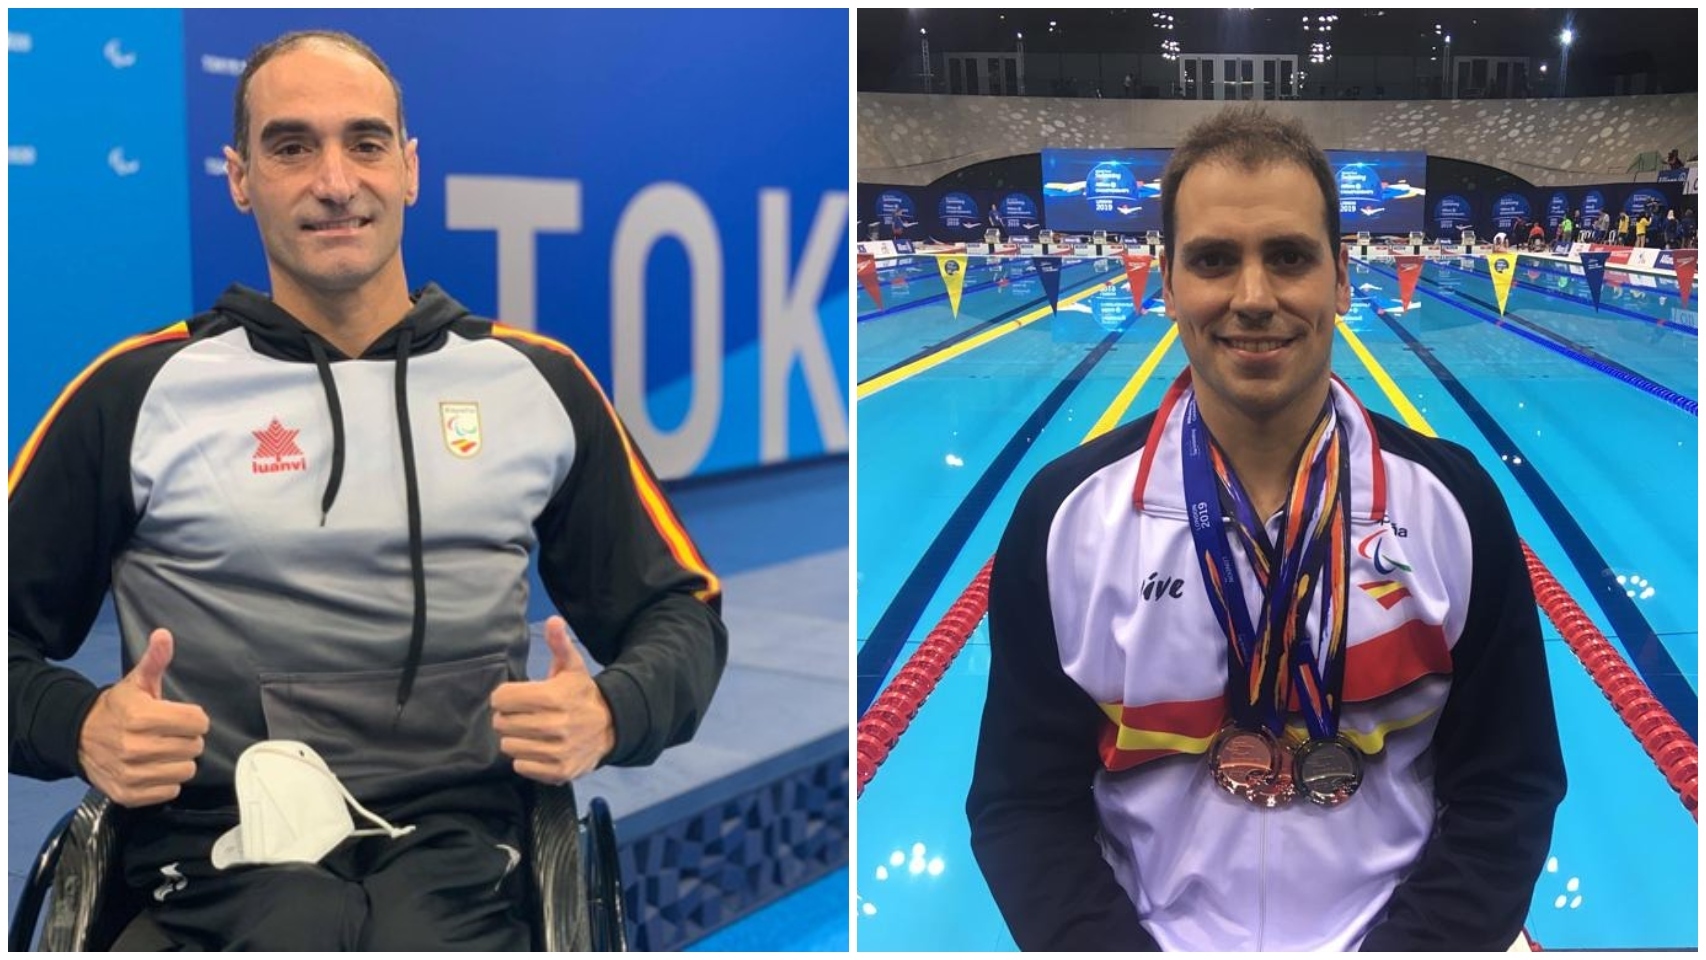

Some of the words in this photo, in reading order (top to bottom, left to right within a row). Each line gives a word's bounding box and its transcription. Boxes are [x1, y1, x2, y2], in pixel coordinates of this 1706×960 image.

[446, 174, 849, 480] TOK
[252, 457, 306, 474] luanvi
[1191, 503, 1202, 531] LONDON
[1198, 501, 1211, 529] 2019
